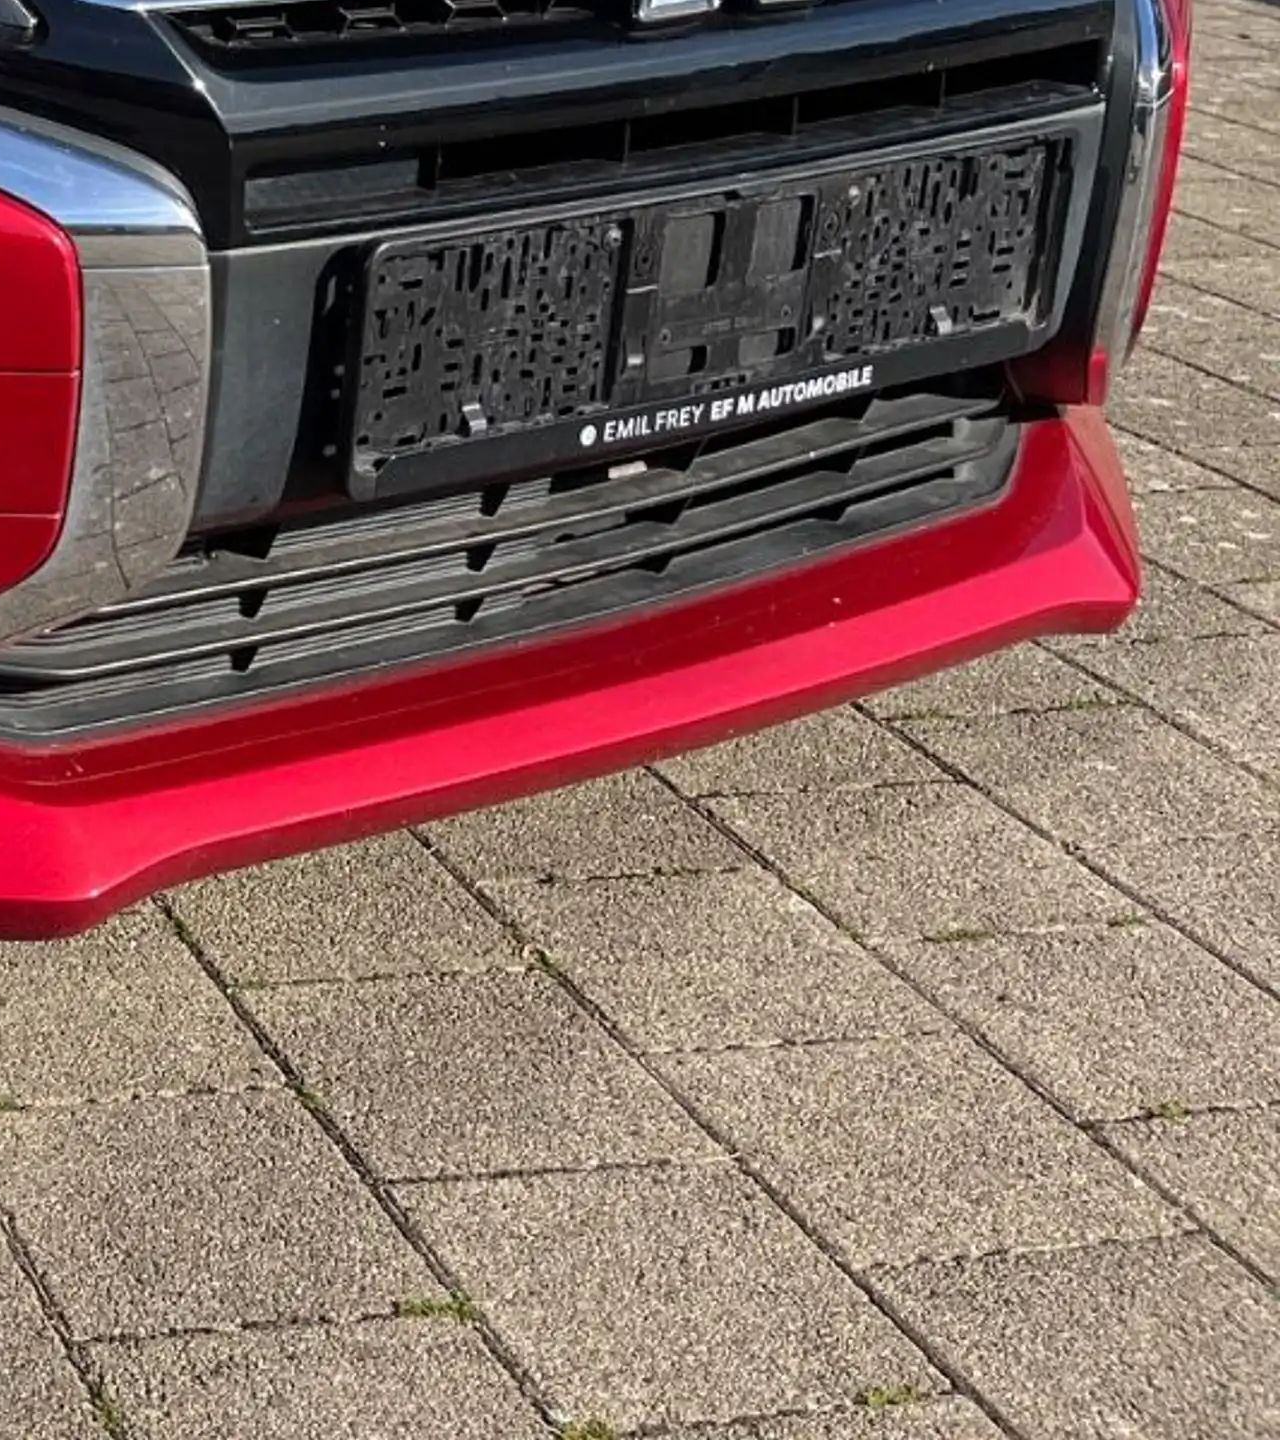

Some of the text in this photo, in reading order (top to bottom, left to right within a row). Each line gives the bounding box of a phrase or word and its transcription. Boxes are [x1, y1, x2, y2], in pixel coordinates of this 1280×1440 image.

[603, 365, 874, 443] EMIL FREY EF M AUTOMOBILE
